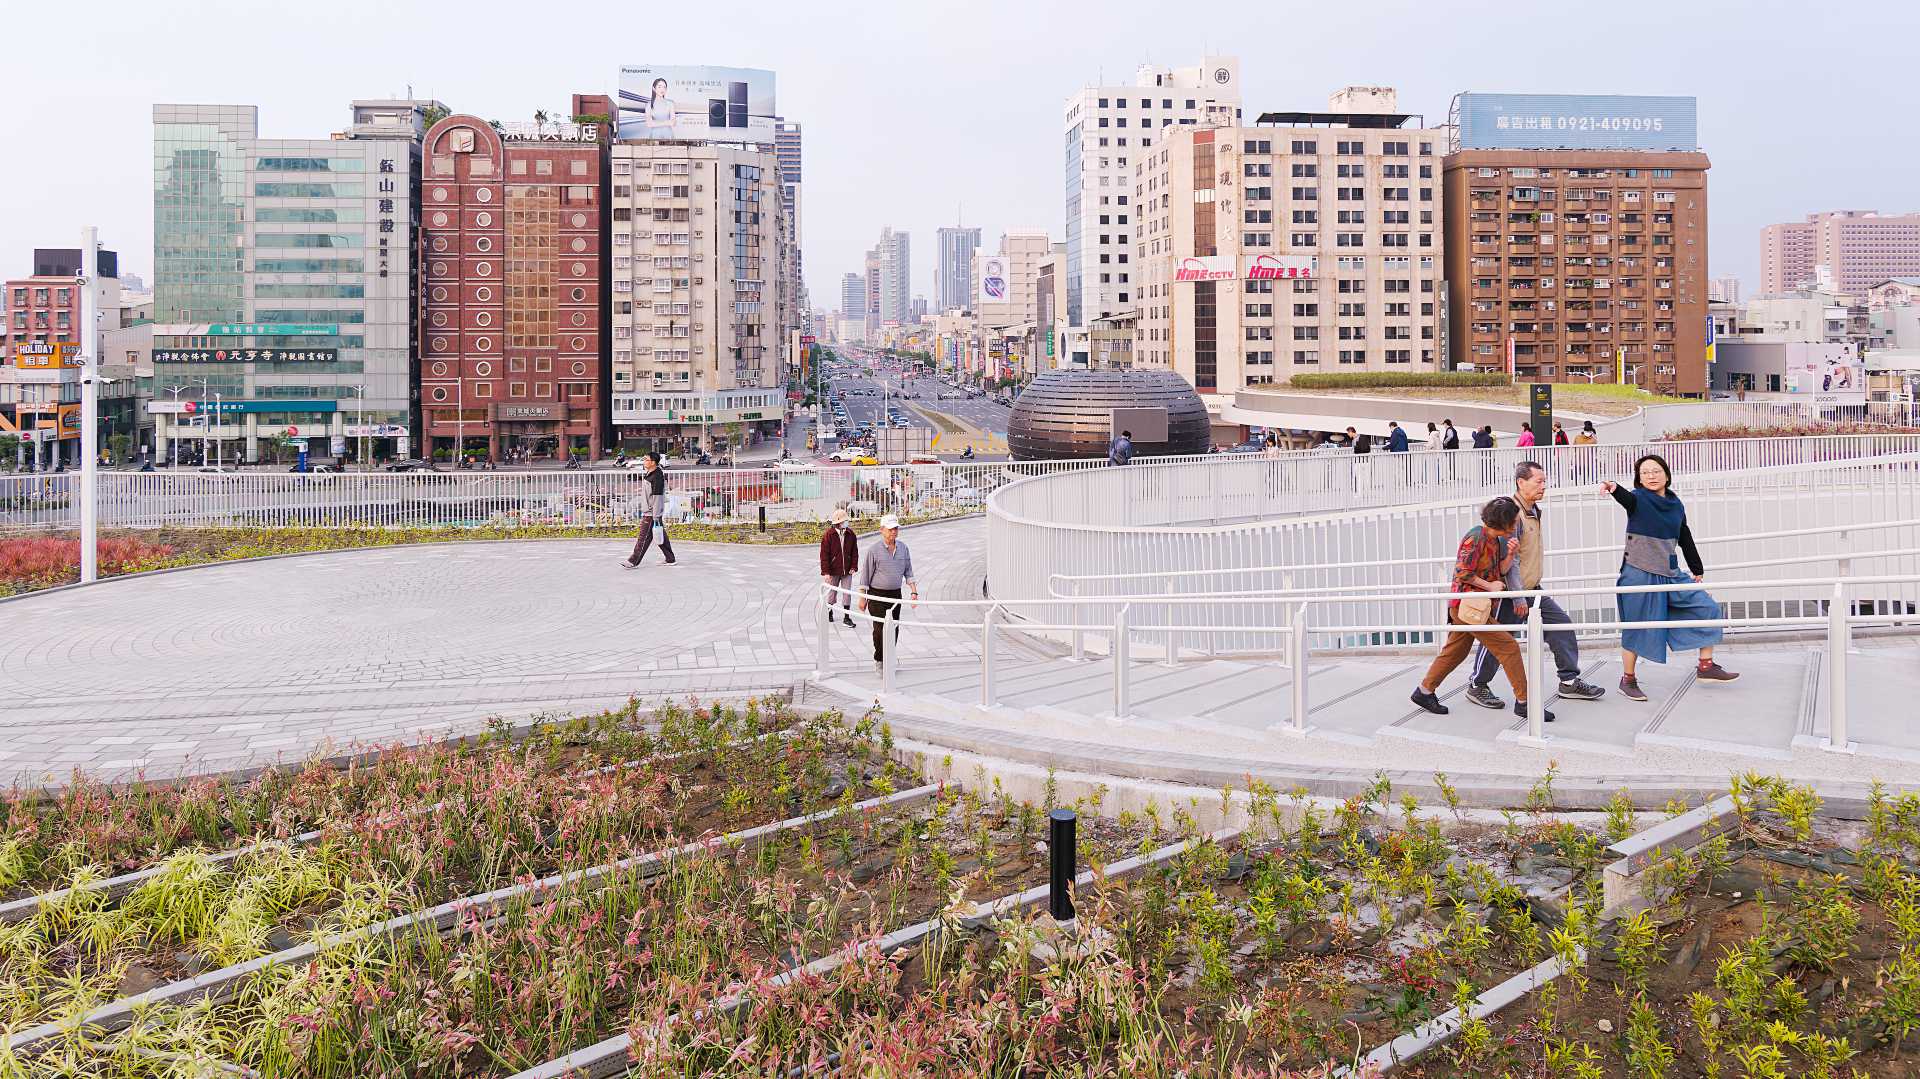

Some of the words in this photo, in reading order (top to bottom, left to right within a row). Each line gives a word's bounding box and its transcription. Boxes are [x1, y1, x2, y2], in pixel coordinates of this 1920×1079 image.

[1496, 116, 1552, 129] 廣告出租
[1557, 116, 1664, 131] 0921-409095
[1209, 271, 1234, 279] CCTV
[19, 344, 55, 355] HOLIDAY
